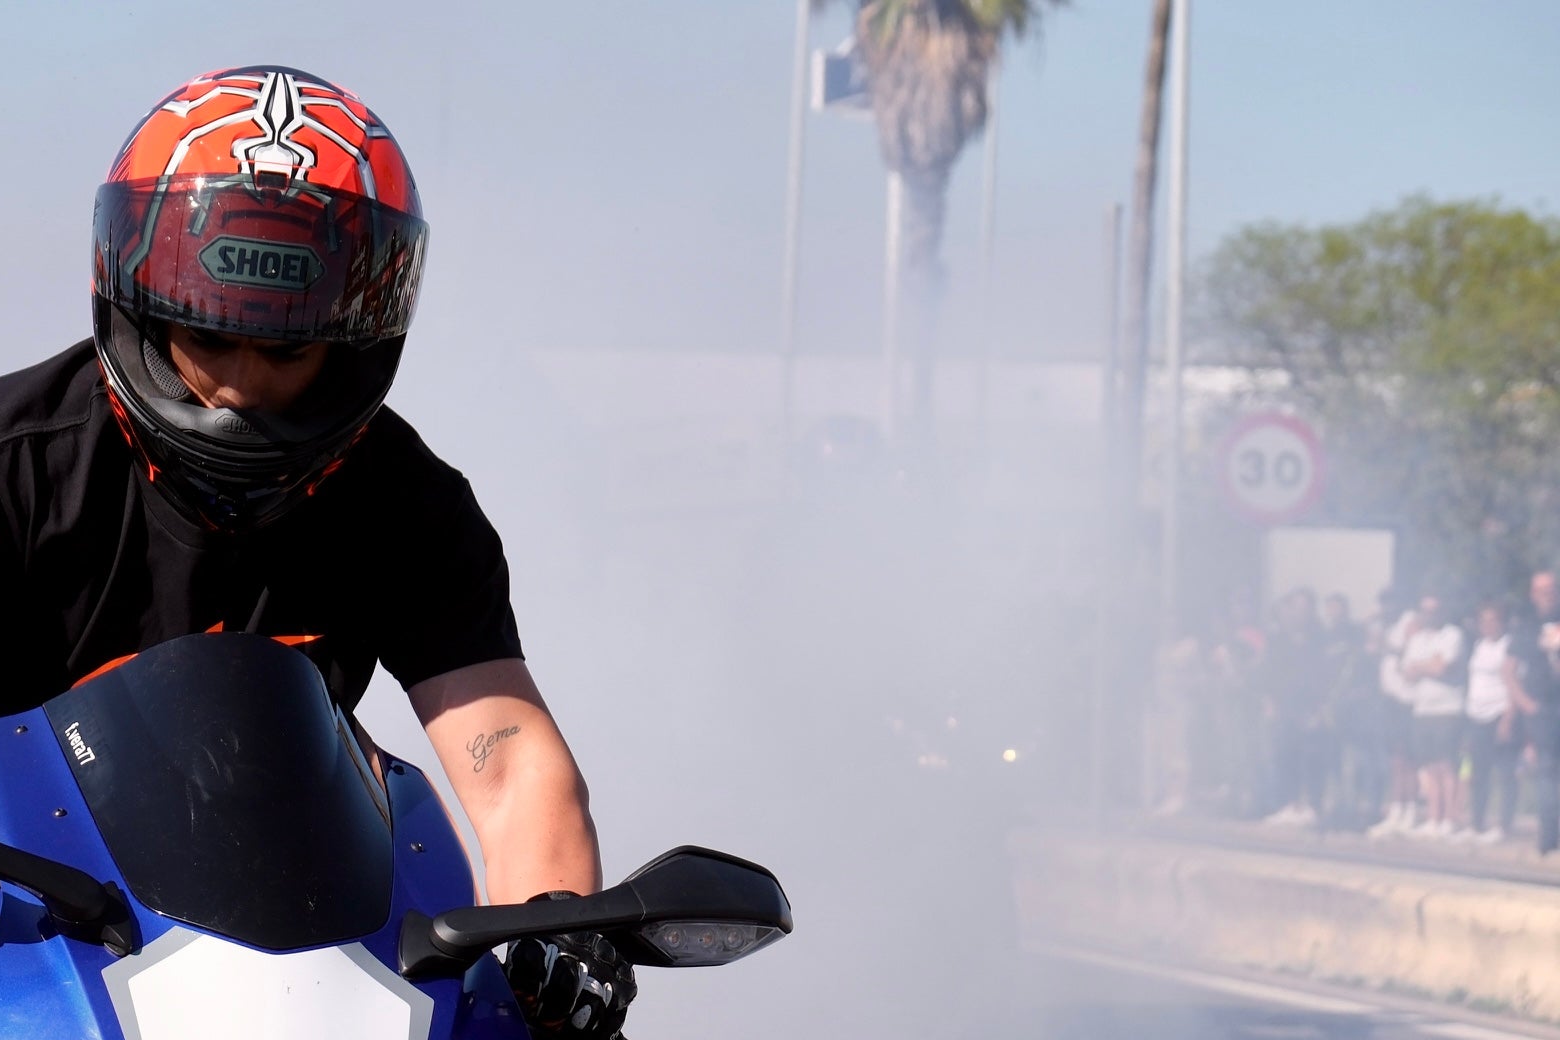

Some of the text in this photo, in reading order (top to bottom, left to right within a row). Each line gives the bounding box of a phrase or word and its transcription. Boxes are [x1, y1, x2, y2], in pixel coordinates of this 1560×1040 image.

[217, 245, 309, 283] SHOEI
[1238, 449, 1304, 489] 30
[65, 722, 96, 765] f.vera77
[466, 725, 521, 773] Gema
